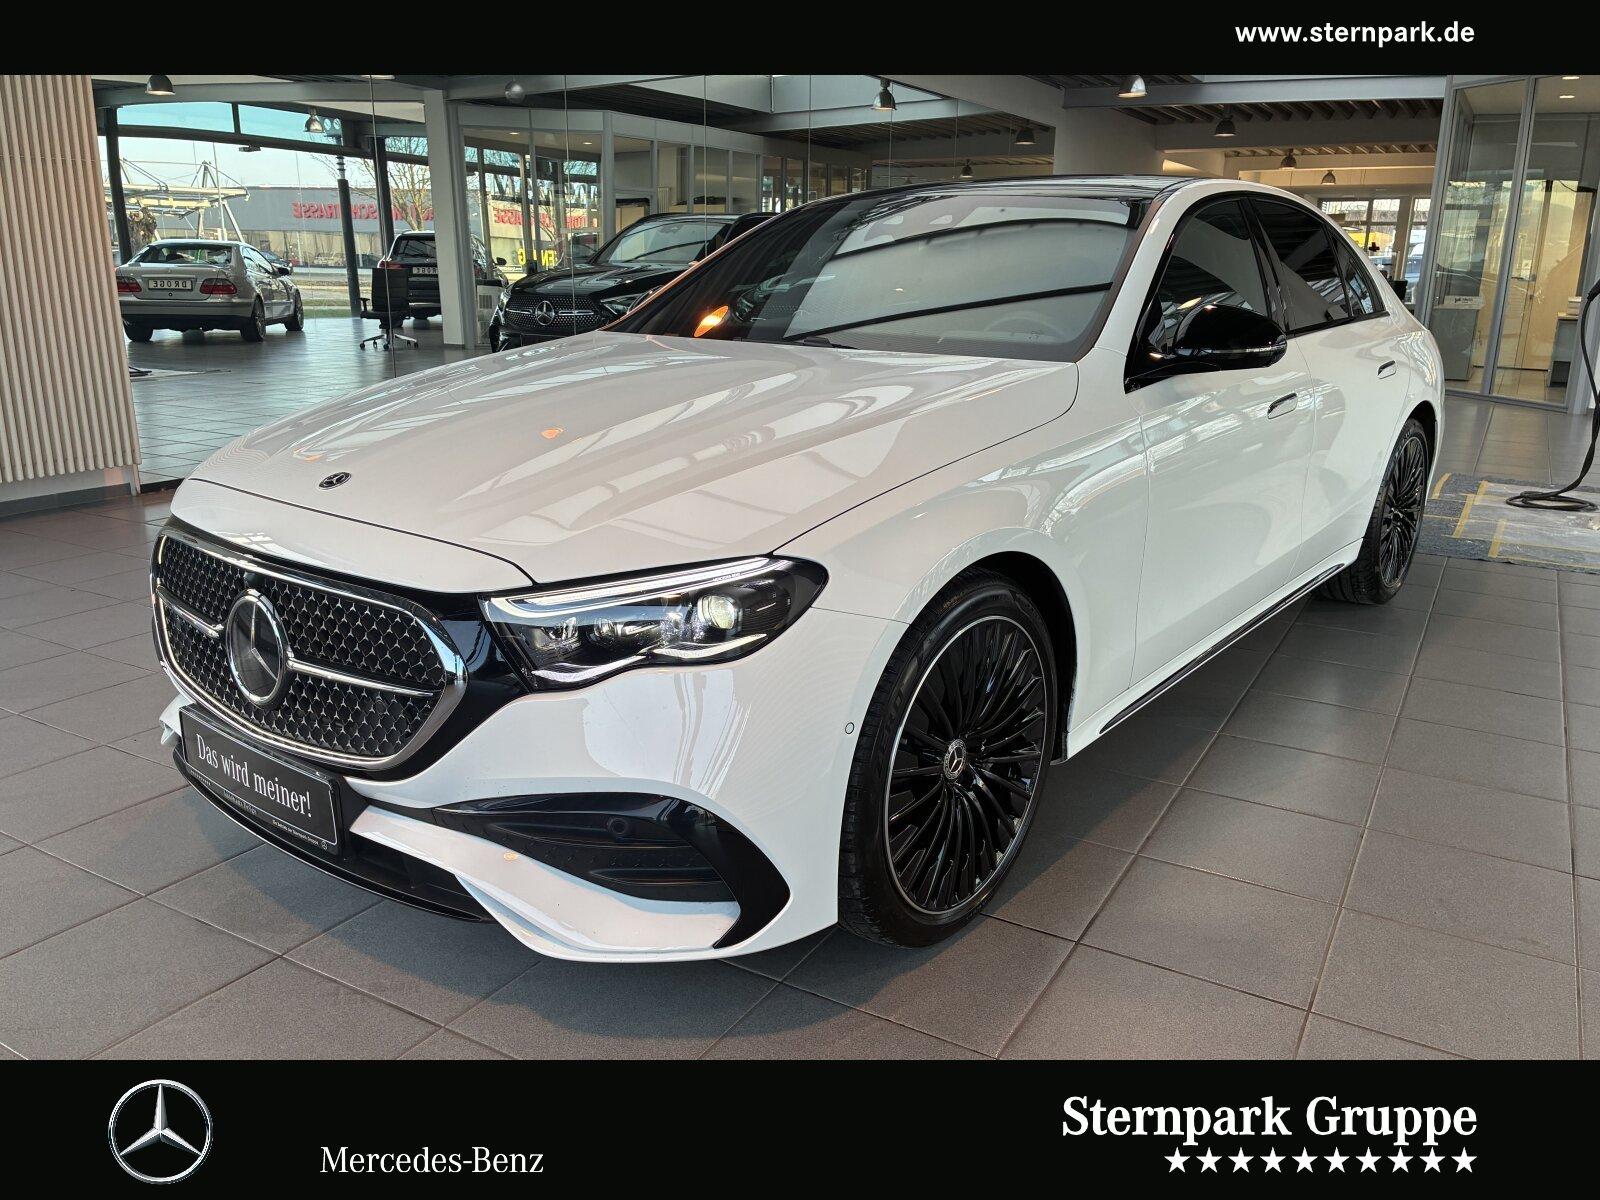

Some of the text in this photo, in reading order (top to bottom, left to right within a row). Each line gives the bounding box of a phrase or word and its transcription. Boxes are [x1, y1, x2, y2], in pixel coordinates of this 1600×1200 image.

[196, 733, 219, 769] Das
[220, 754, 251, 788] wird
[253, 772, 313, 818] meiner!
